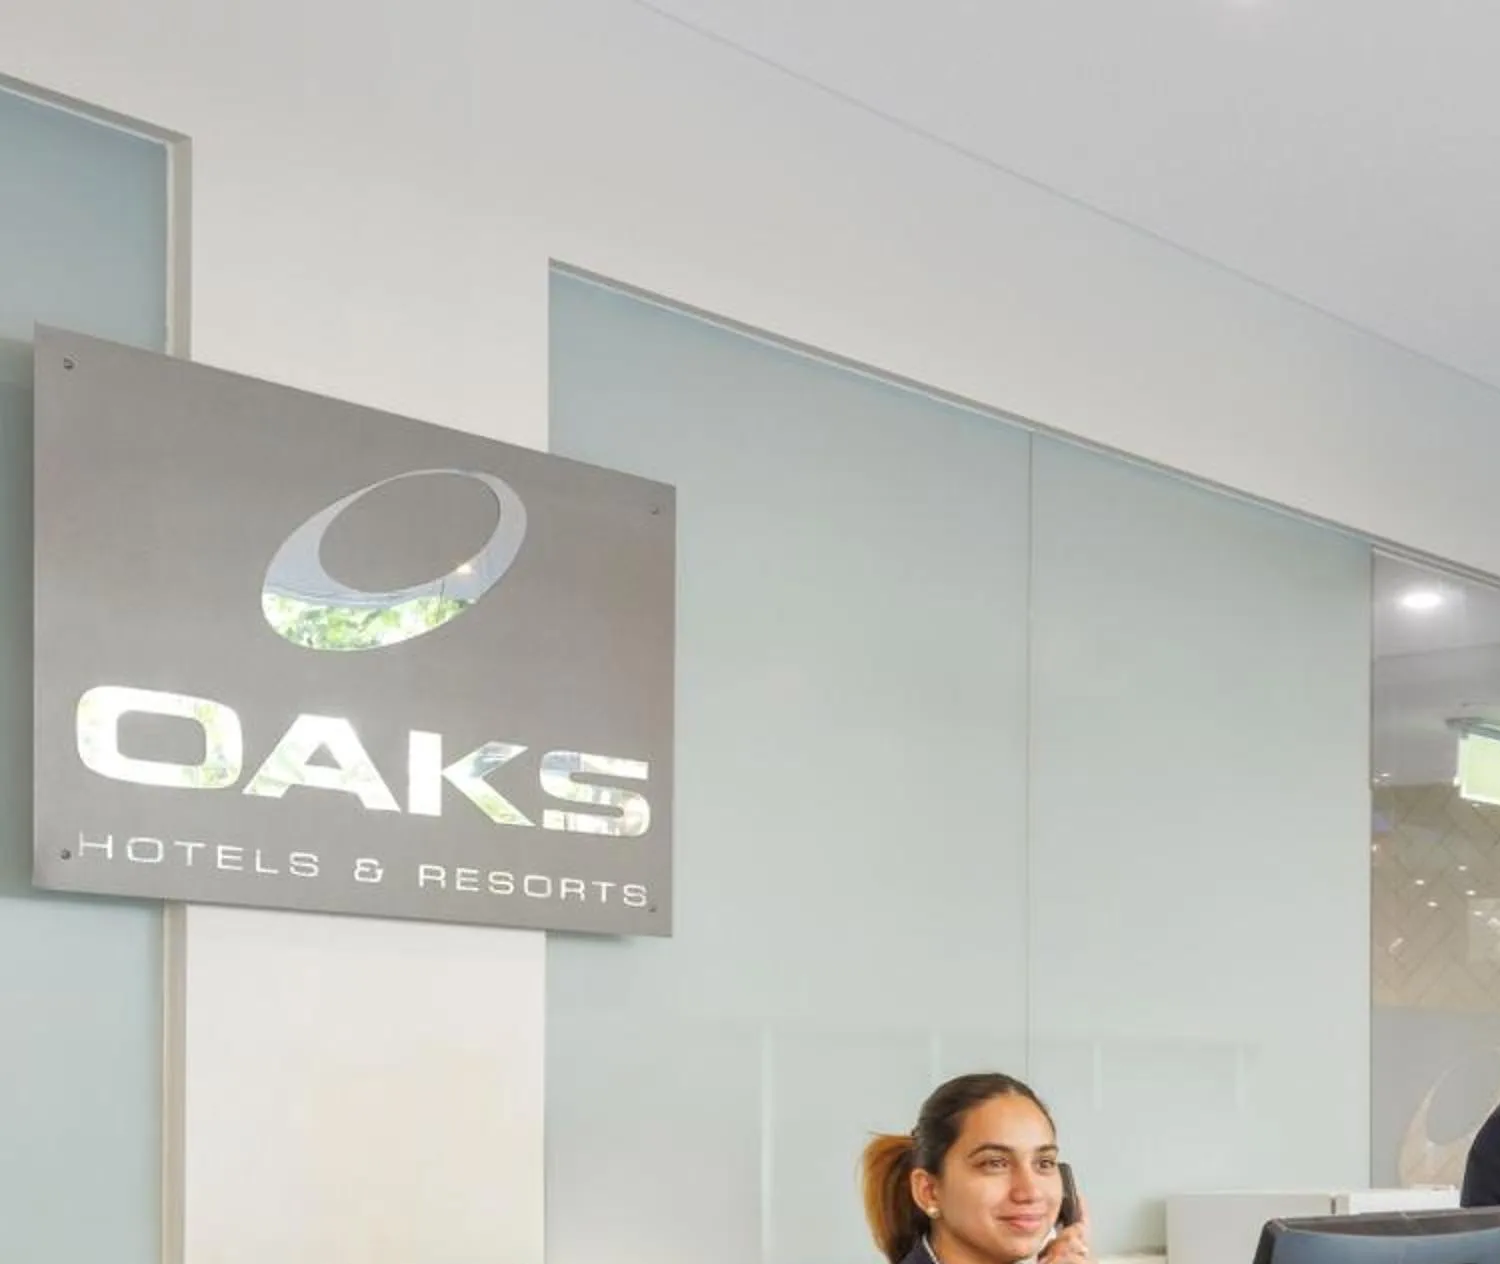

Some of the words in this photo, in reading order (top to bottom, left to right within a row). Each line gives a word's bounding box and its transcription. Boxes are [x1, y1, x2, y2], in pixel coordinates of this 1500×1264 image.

[76, 685, 651, 838] OAKS
[78, 830, 320, 877] HOTELS
[353, 858, 384, 883] &
[418, 864, 649, 908] RESORTS
